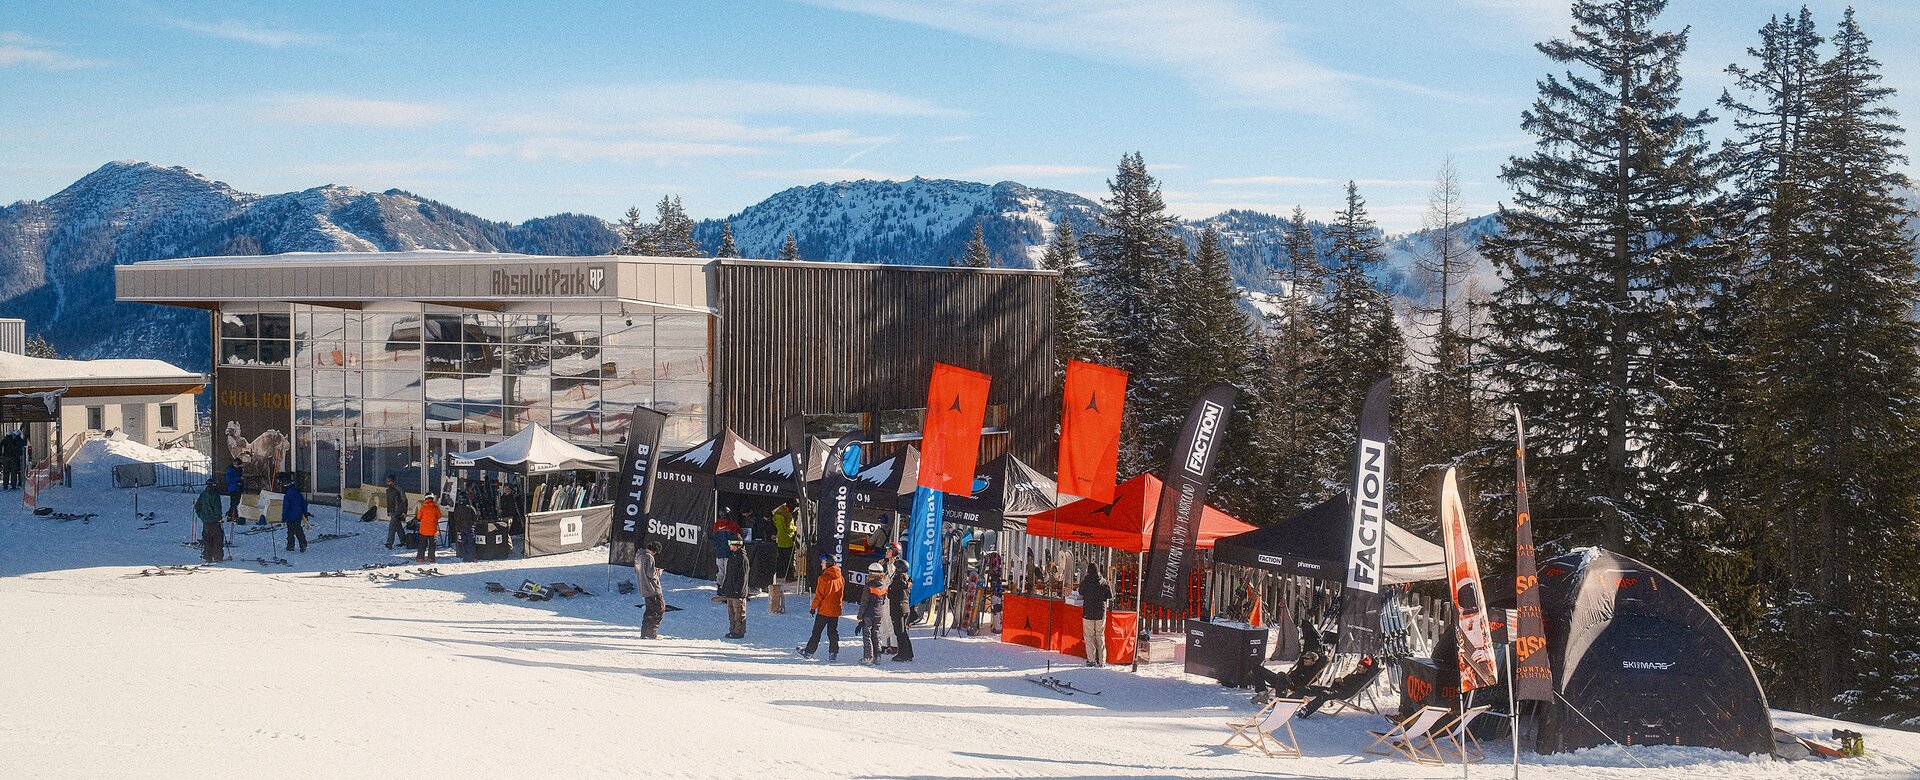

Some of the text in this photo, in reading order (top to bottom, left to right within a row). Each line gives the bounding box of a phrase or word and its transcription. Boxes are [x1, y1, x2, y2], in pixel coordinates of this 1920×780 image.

[492, 266, 585, 295] AbsolutPark
[221, 390, 291, 410] CHILL HOU
[1188, 405, 1219, 471] FACTION
[657, 471, 693, 483] BURTON
[623, 444, 650, 532] BURTON
[739, 482, 779, 493] BURTON
[1014, 480, 1051, 491] SNOW
[963, 512, 980, 522] RIDE
[1353, 446, 1381, 586] FACTION
[1259, 555, 1282, 565] FACTION
[1161, 581, 1175, 599] THE
[1516, 666, 1551, 674] OUNTAIN
